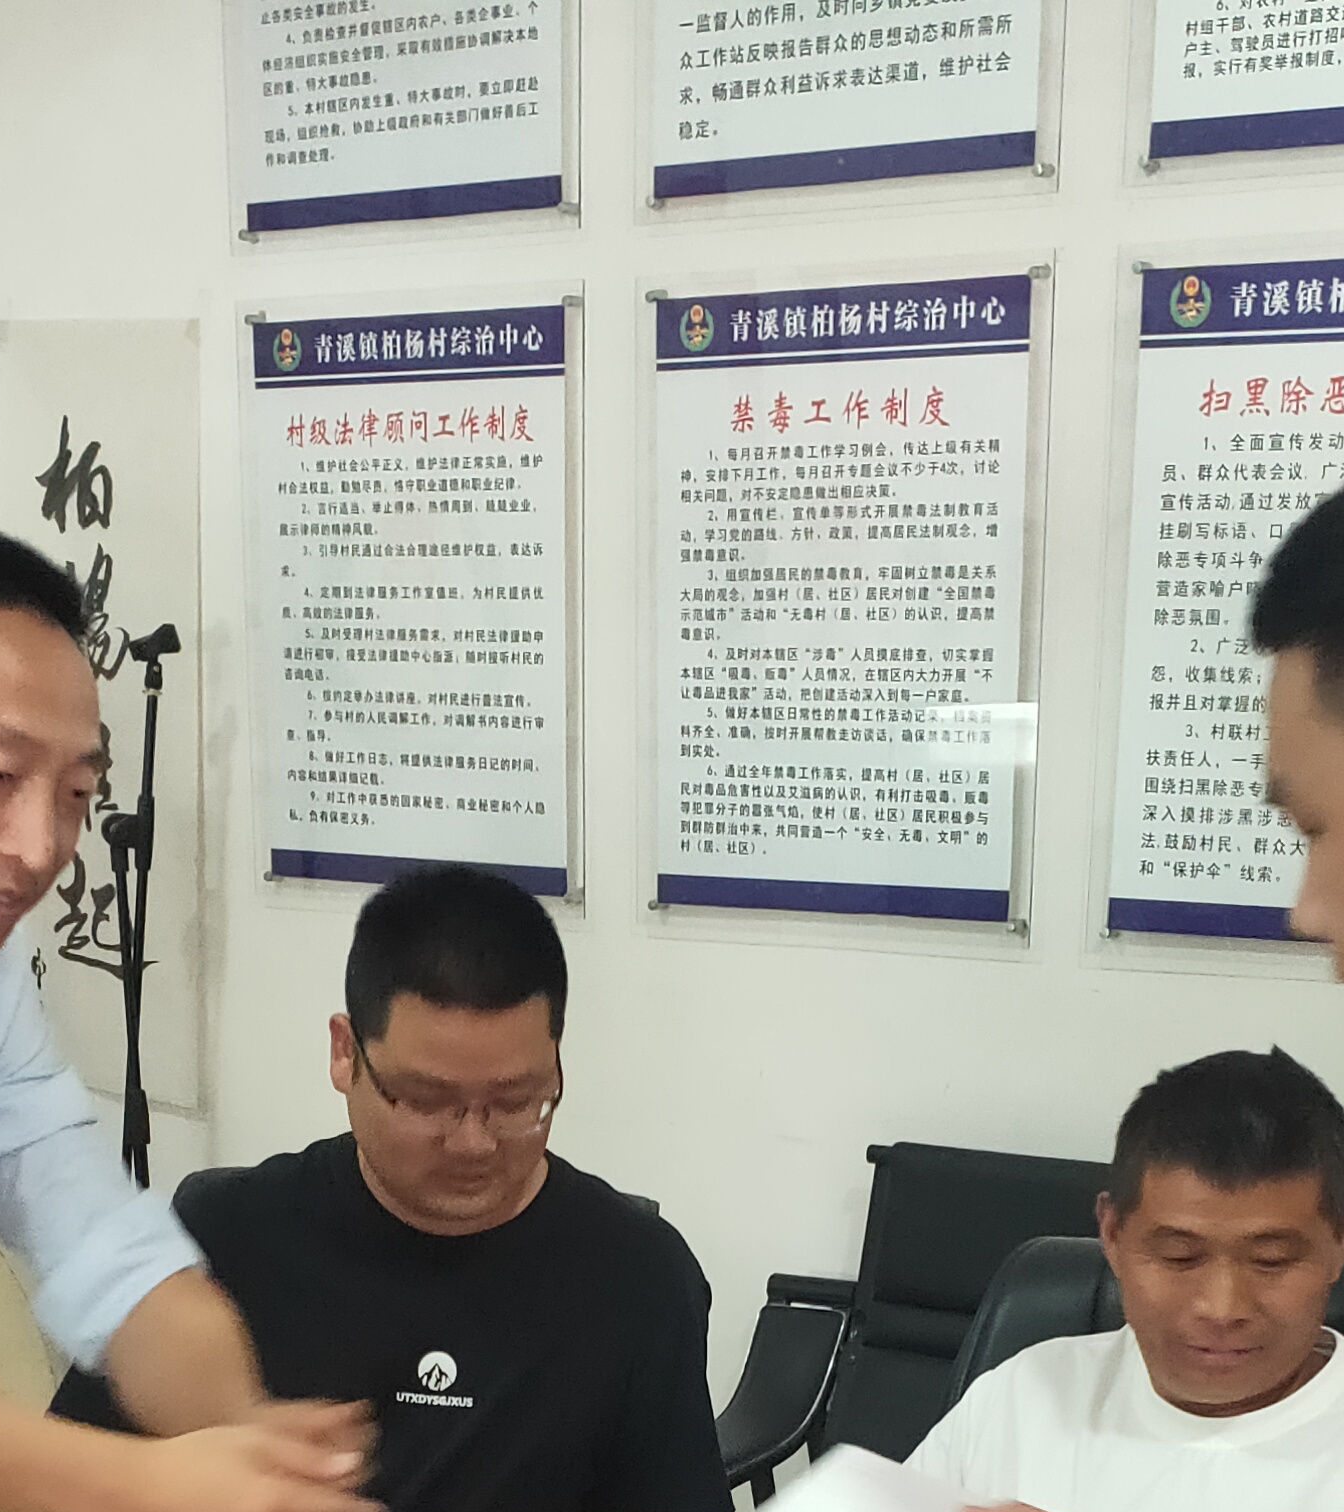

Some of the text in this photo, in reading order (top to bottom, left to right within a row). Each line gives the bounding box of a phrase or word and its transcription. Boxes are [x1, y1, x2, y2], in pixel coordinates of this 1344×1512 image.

[731, 294, 1005, 341] 青溪镇柏杨村综治中心
[315, 322, 543, 363] 青溪镇柏杨村综治中心
[731, 386, 950, 434] 禁毒工作制度
[286, 404, 534, 448] 村级法律顾问工作制度
[1159, 522, 1300, 541] 挂刷写标语、口
[1153, 607, 1228, 626] 除恶氛围。
[680, 743, 719, 757] 到实处。
[1144, 776, 1266, 797] 围绕扫黑除恶专
